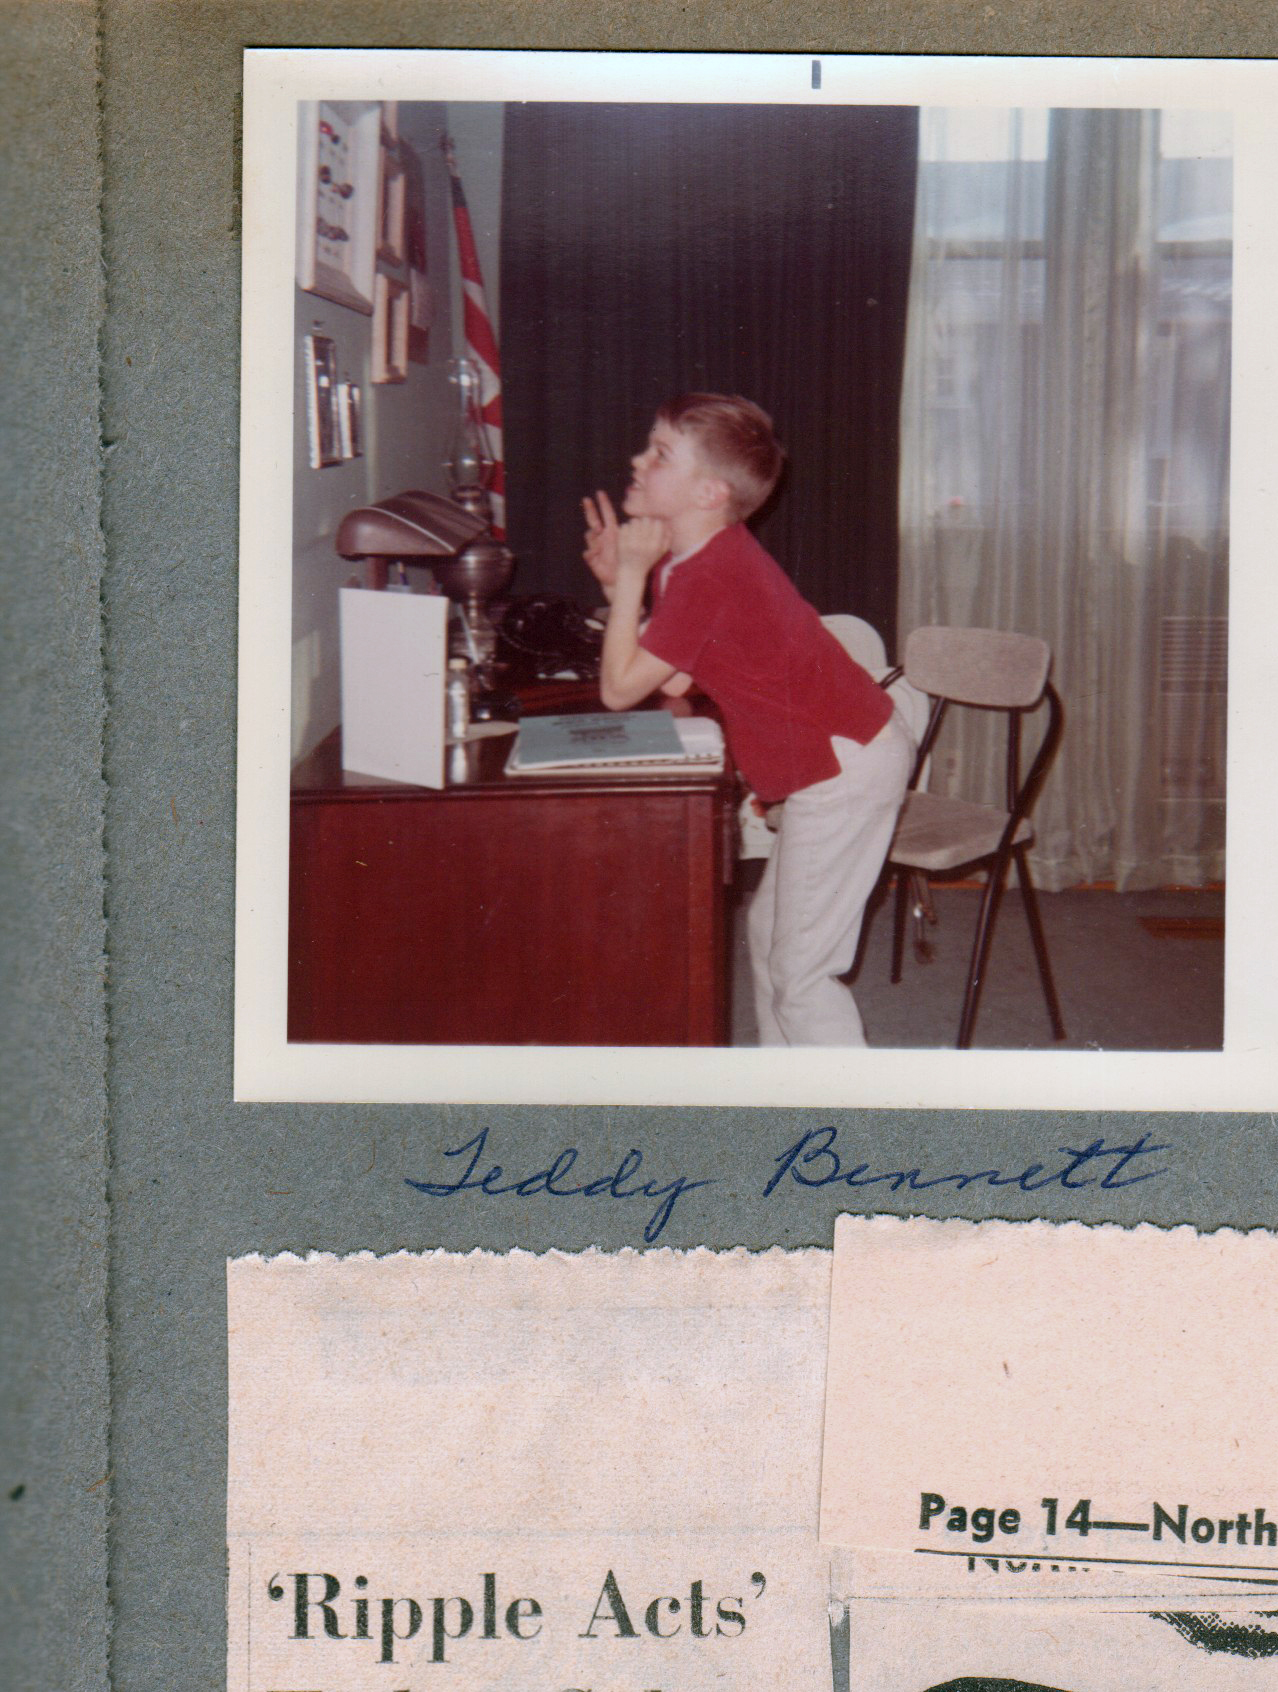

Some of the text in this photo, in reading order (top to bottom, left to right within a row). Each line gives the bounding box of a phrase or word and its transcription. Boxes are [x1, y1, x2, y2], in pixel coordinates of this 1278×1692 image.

[406, 1126, 1170, 1241] Teddy Bennett
[920, 1493, 1020, 1543] Page
